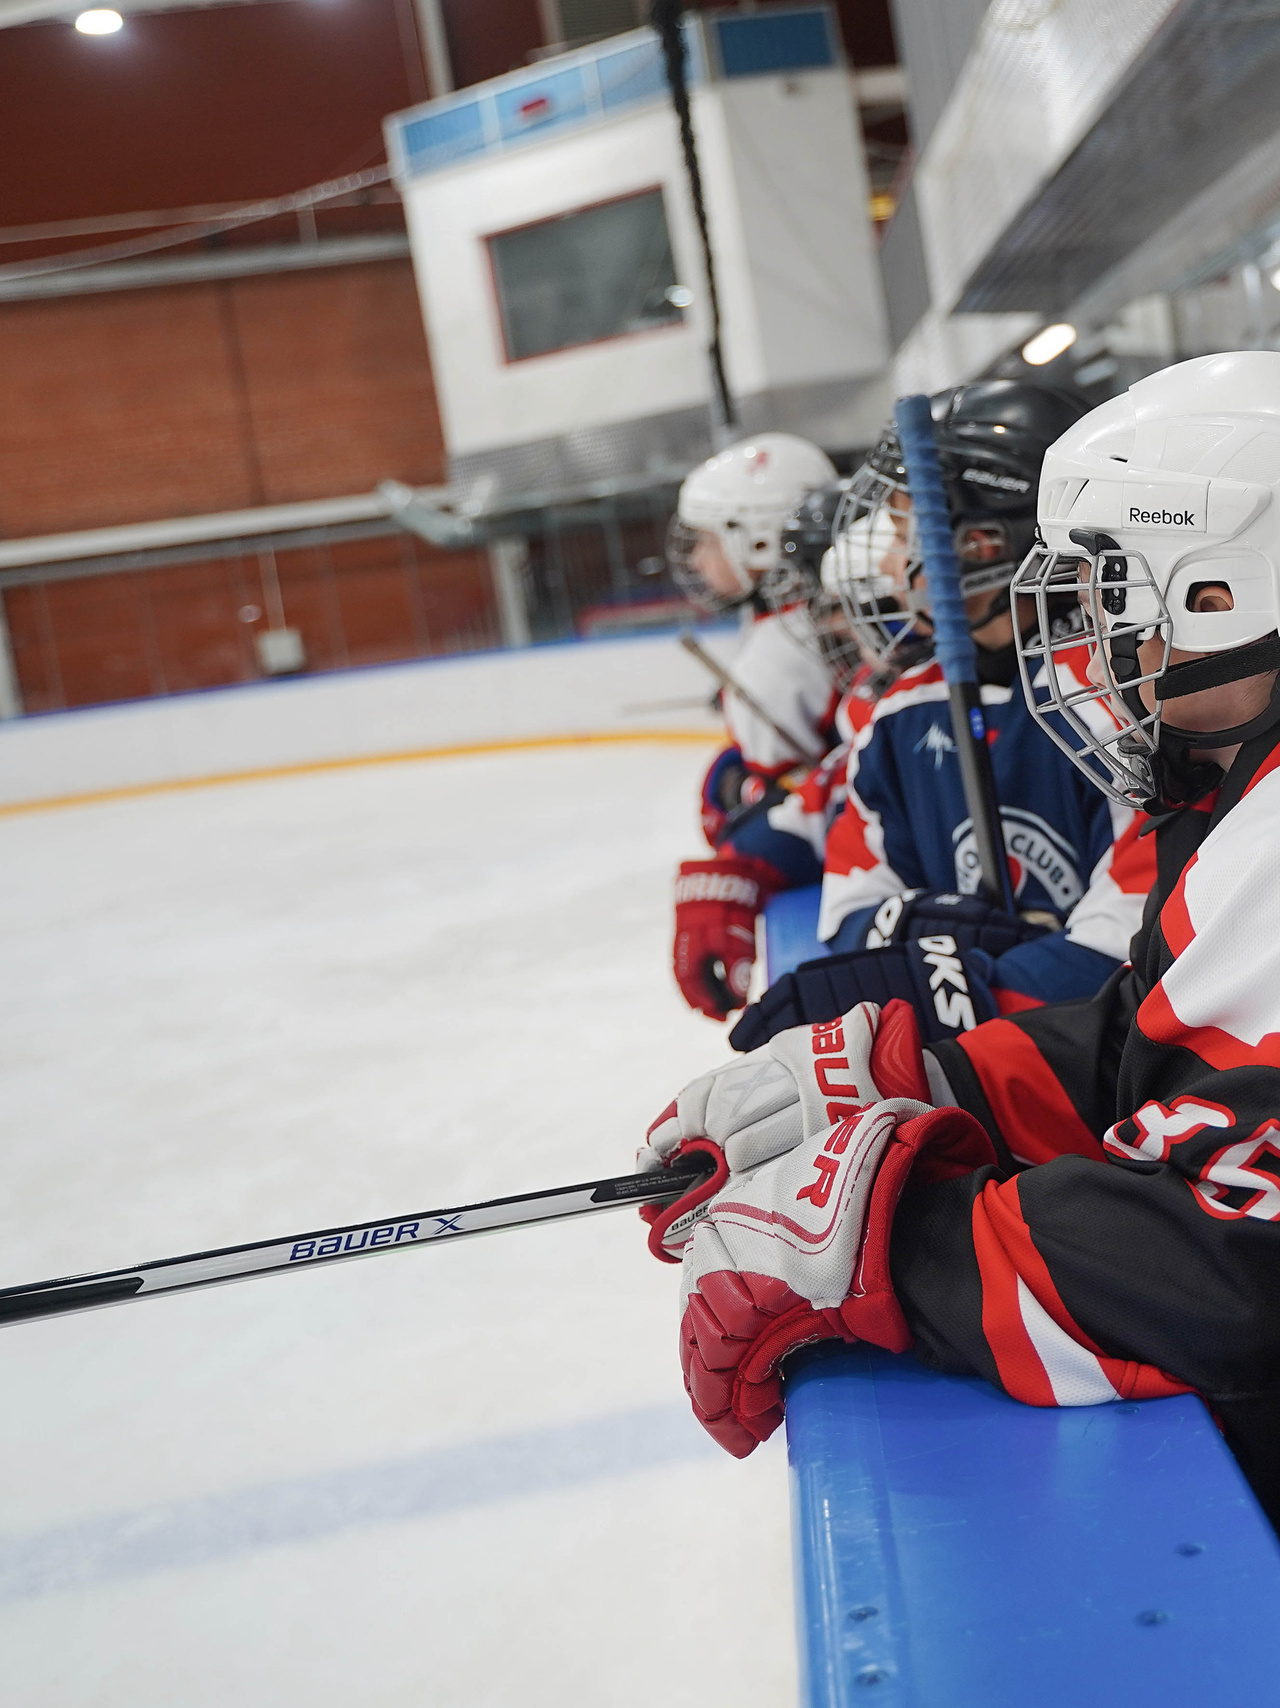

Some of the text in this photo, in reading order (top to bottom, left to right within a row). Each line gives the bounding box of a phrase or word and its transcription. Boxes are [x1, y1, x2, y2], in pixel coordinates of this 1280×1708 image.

[961, 467, 1031, 494] BAUER
[1129, 507, 1195, 525] Reebok
[1010, 833, 1064, 884] CLUB
[289, 1222, 420, 1262] BAUER
